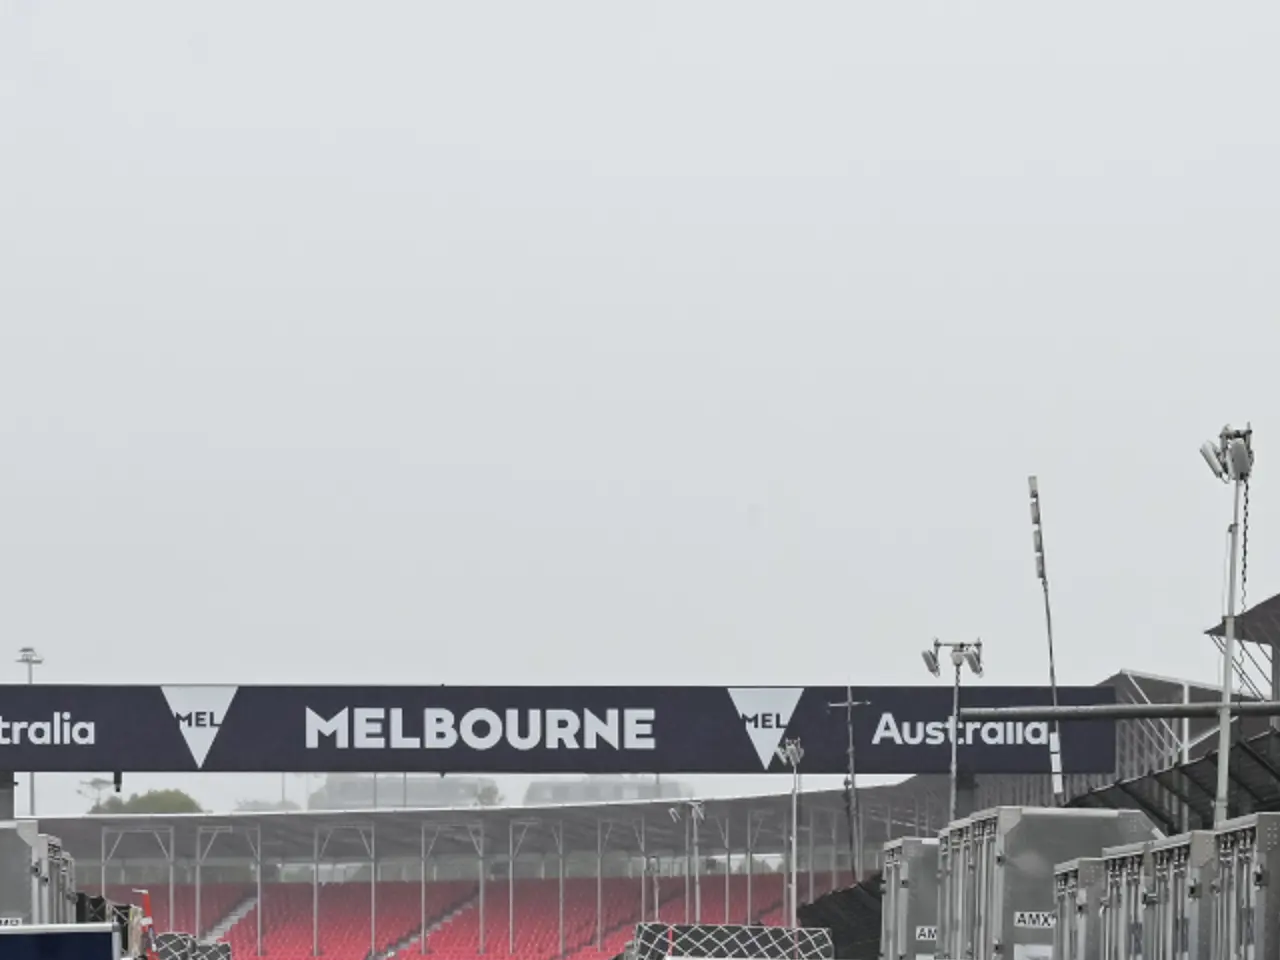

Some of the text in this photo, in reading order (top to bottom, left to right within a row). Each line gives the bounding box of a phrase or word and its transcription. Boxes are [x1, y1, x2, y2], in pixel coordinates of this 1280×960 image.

[175, 711, 222, 727] MEL
[305, 706, 655, 750] MELBOURNE
[741, 712, 787, 729] MEL
[872, 712, 1049, 745] Australia
